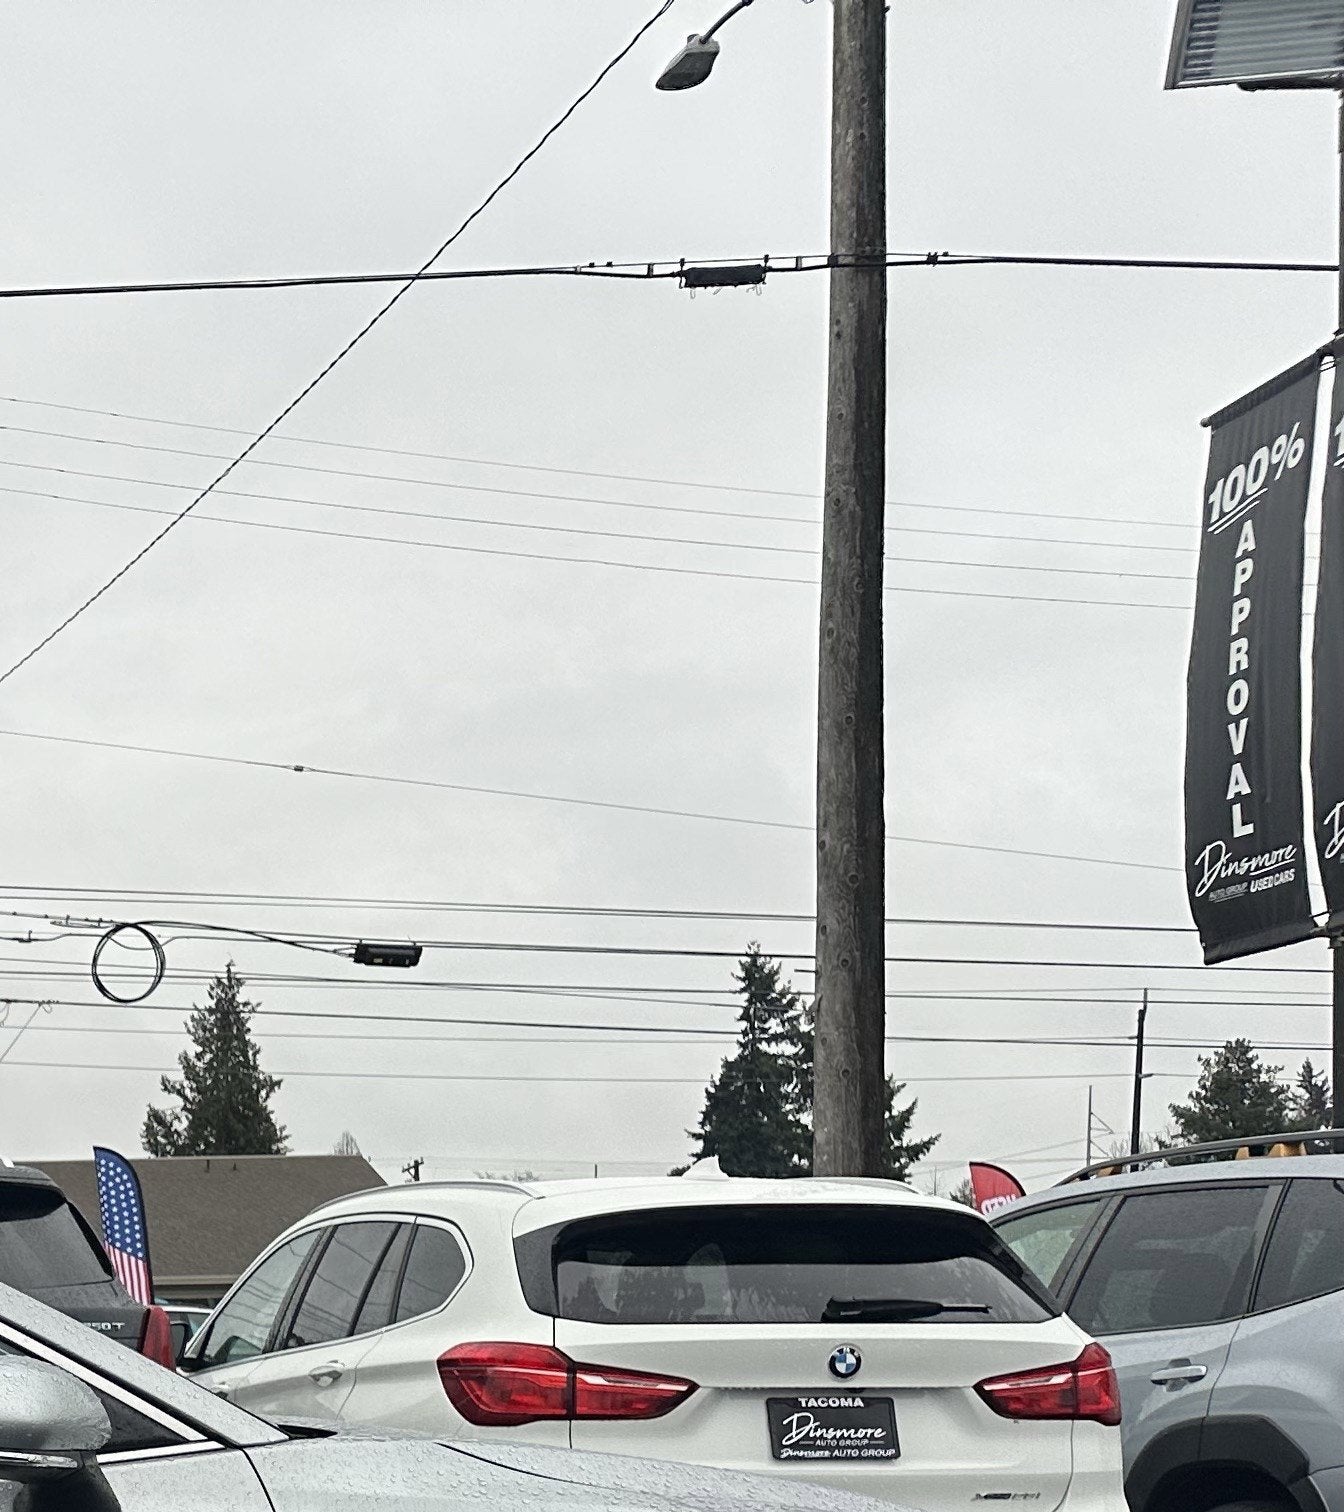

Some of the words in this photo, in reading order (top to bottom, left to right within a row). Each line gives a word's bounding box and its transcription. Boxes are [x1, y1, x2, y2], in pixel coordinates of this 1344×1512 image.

[1207, 421, 1305, 523] 100%
[1226, 519, 1257, 838] APPROVAL
[1194, 840, 1297, 897] Dinsmore
[798, 1397, 864, 1408] TACOMA
[782, 1411, 887, 1446] Dinsmore
[815, 1438, 837, 1447] AUTO
[838, 1438, 869, 1447] GROUP
[832, 1448, 859, 1458] AUTO
[860, 1448, 896, 1458] GROUP
